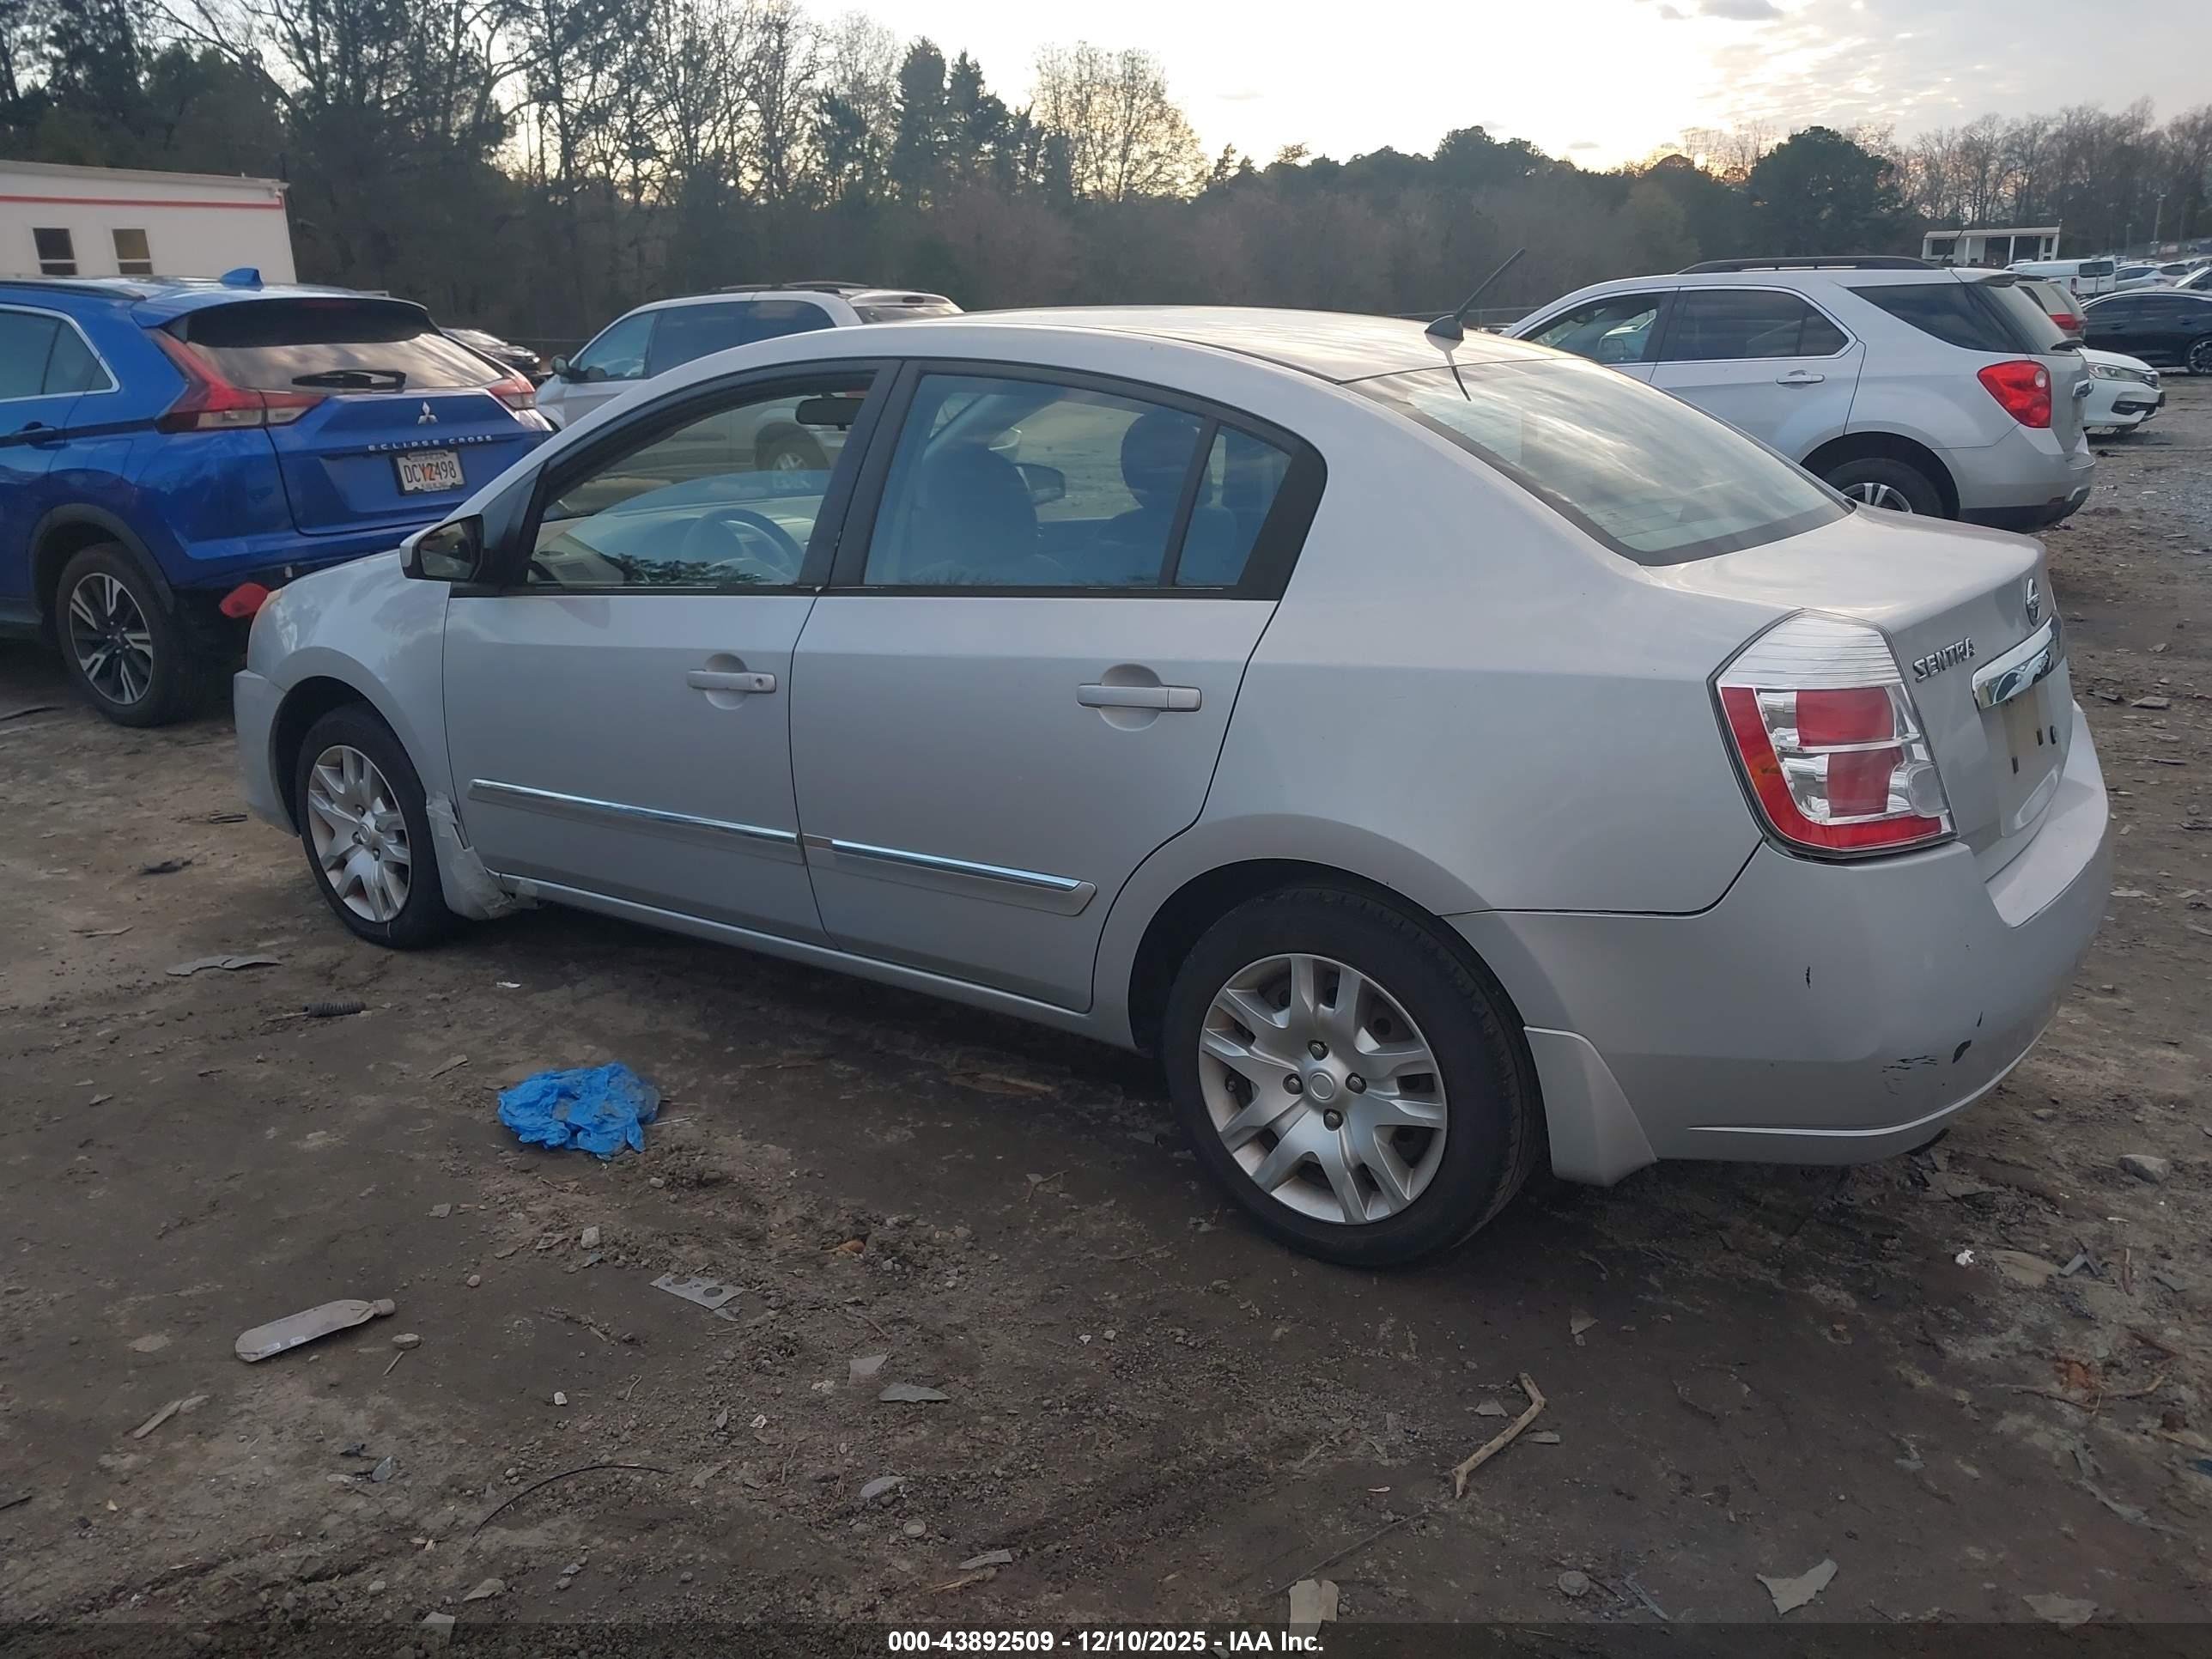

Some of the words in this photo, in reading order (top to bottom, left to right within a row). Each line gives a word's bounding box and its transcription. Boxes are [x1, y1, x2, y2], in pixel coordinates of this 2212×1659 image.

[368, 440, 440, 451] ECLIPSE
[448, 434, 493, 445] CROSS
[404, 460, 457, 483] DCY2498
[1912, 636, 1975, 683] SENTRA
